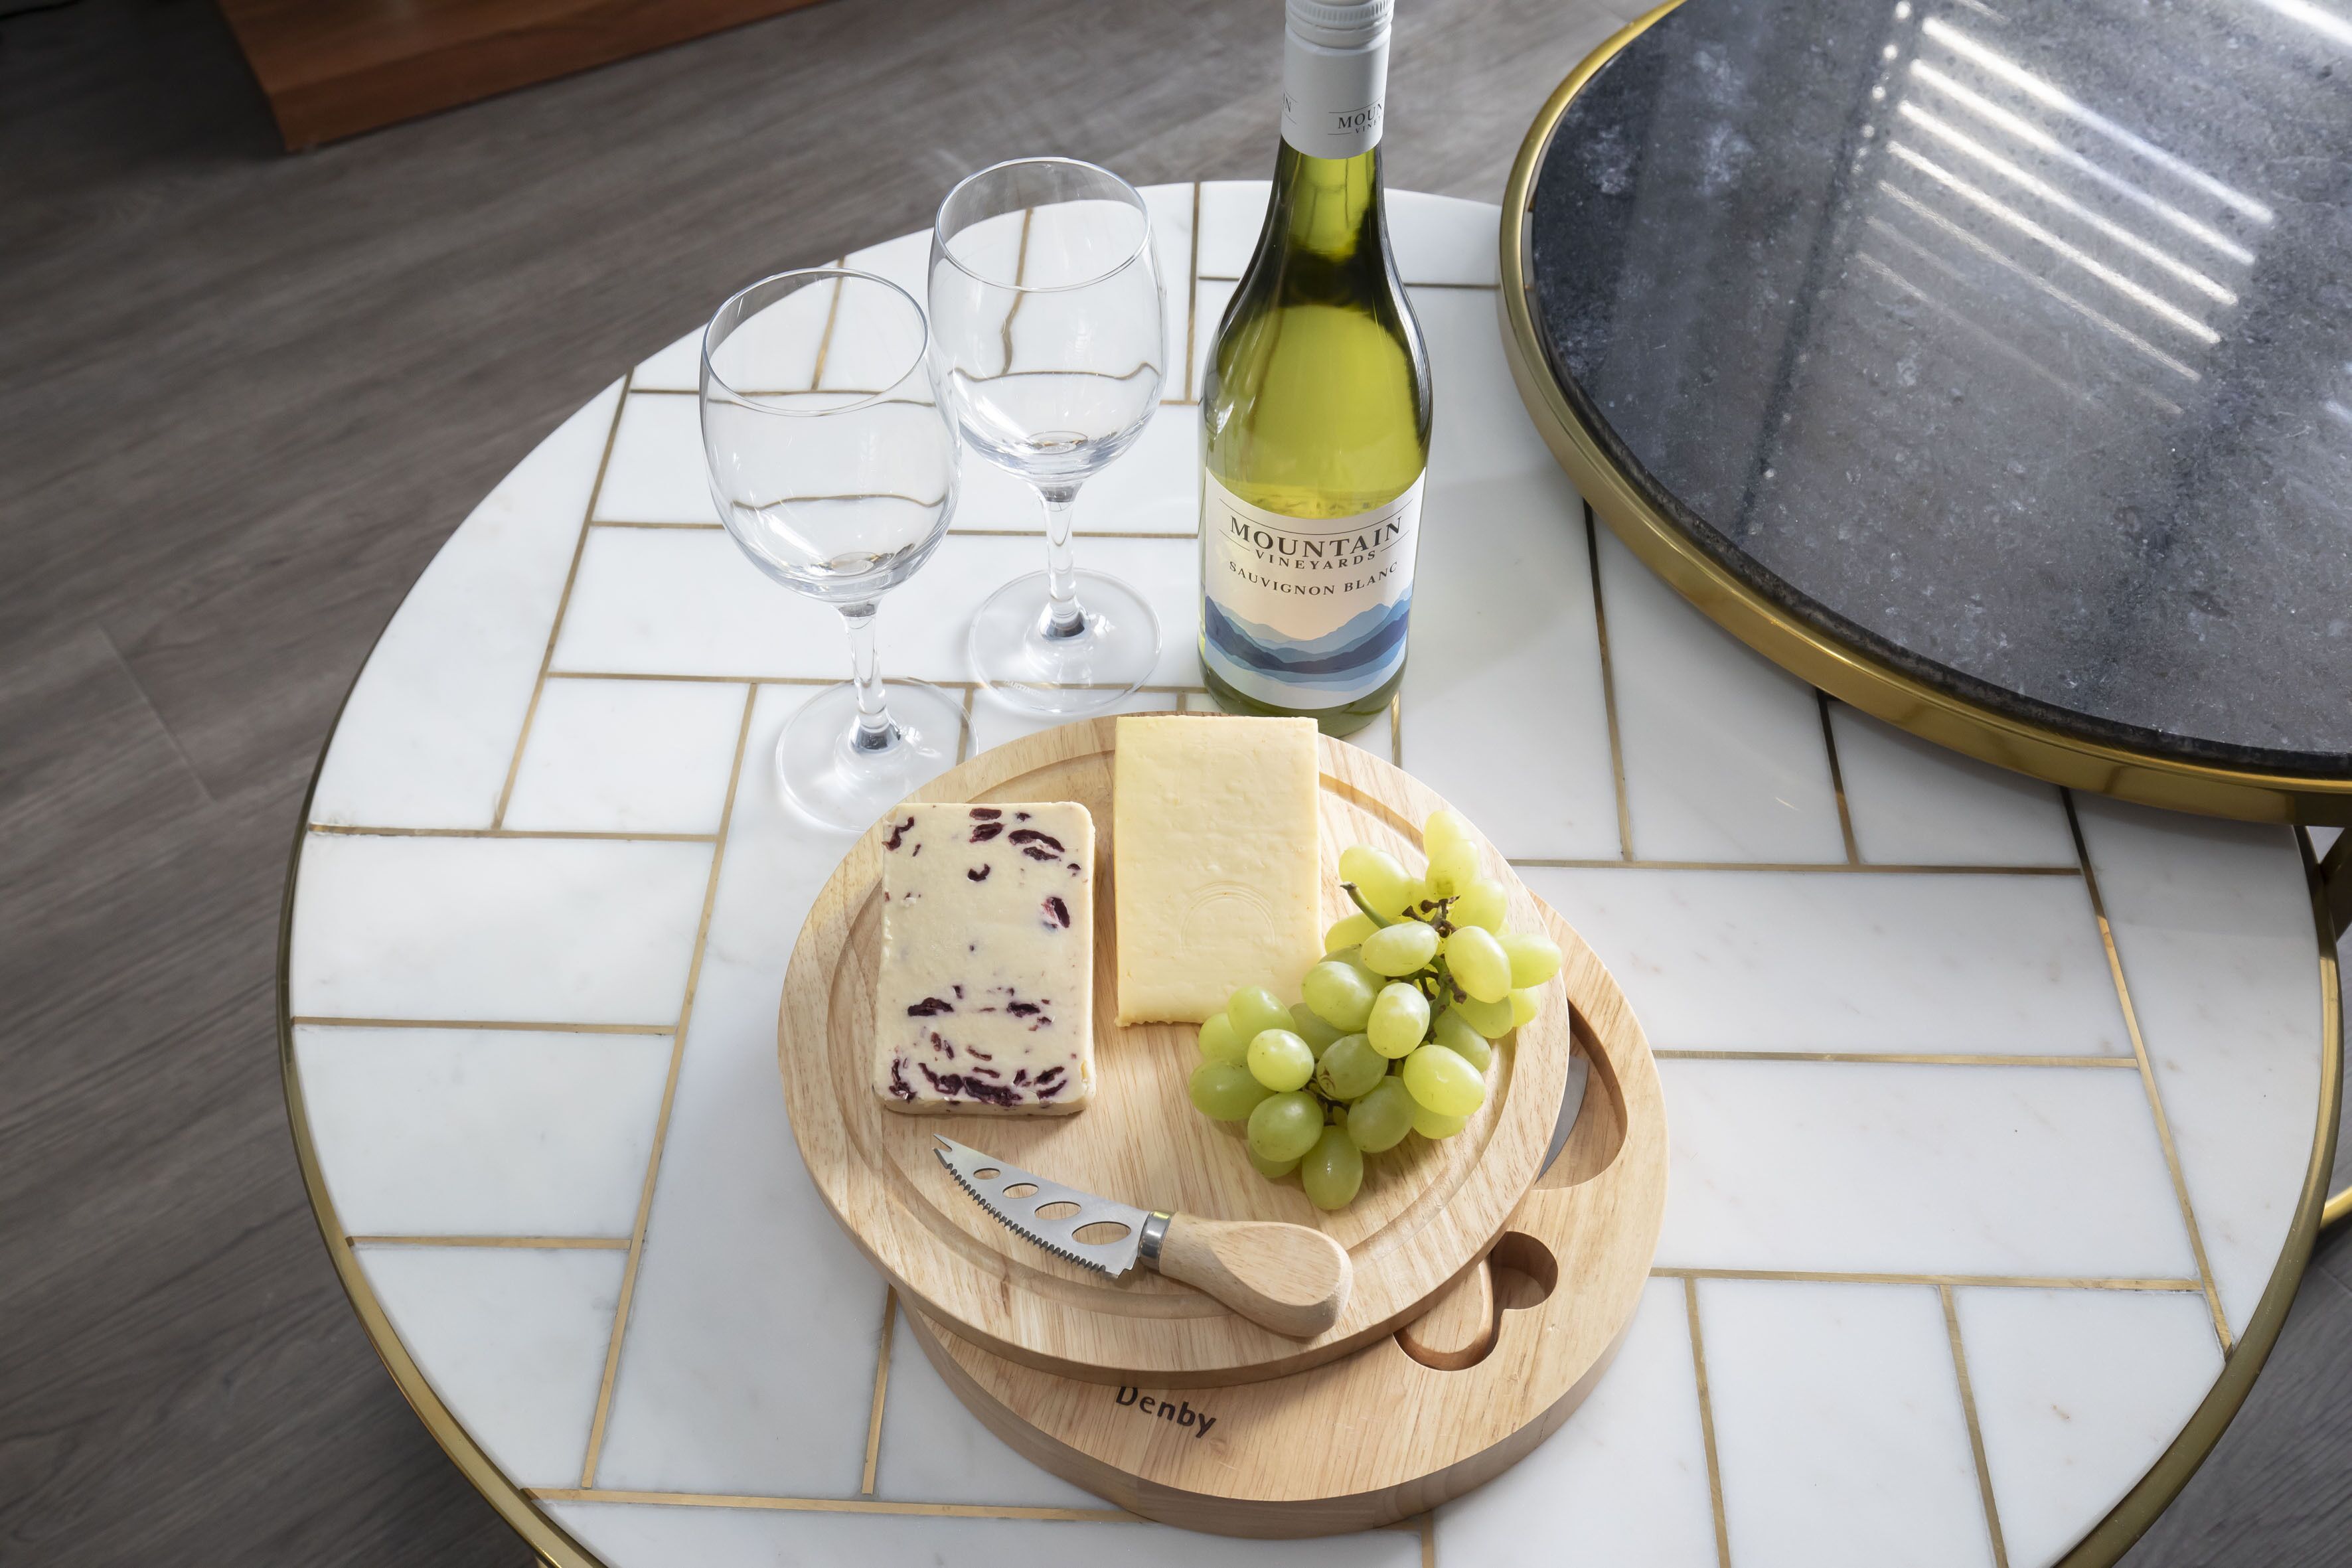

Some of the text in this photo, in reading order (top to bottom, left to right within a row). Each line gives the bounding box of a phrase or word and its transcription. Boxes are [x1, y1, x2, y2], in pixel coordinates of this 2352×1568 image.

[1338, 103, 1382, 129] MOUN
[1230, 515, 1402, 558] MOUNTAIN
[1255, 549, 1376, 570] VINEYARDS
[1229, 561, 1398, 595] SAUVIGNON BLANC
[1115, 1385, 1217, 1439] Denby
